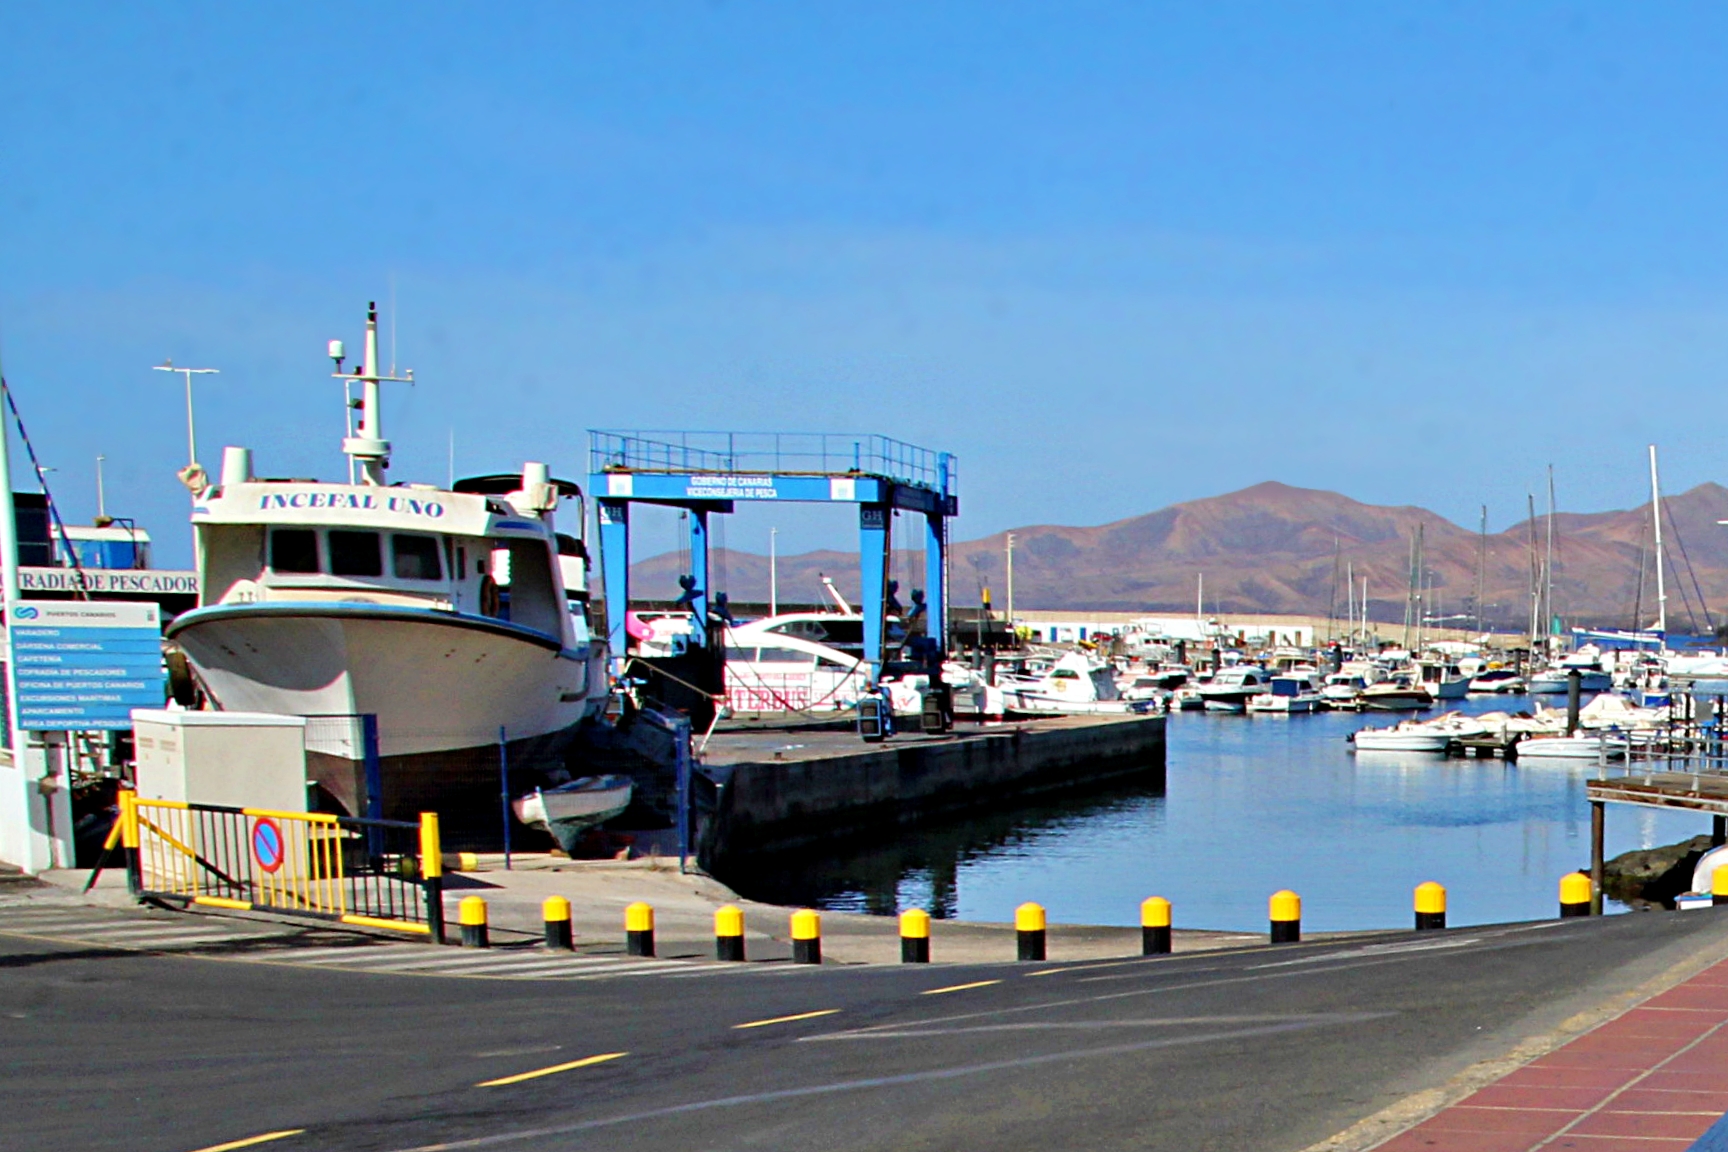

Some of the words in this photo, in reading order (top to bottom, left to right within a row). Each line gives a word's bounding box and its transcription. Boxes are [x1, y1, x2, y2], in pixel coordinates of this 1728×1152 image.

[691, 476, 727, 486] GOBIERNO
[728, 477, 737, 486] DE
[738, 477, 773, 487] CANARIAS
[745, 488, 754, 498] DE
[755, 488, 777, 498] PESCA
[260, 493, 378, 510] INCEFAL
[388, 496, 444, 518] UNO
[20, 573, 80, 589] RADIA
[110, 575, 198, 592] PESCADOR
